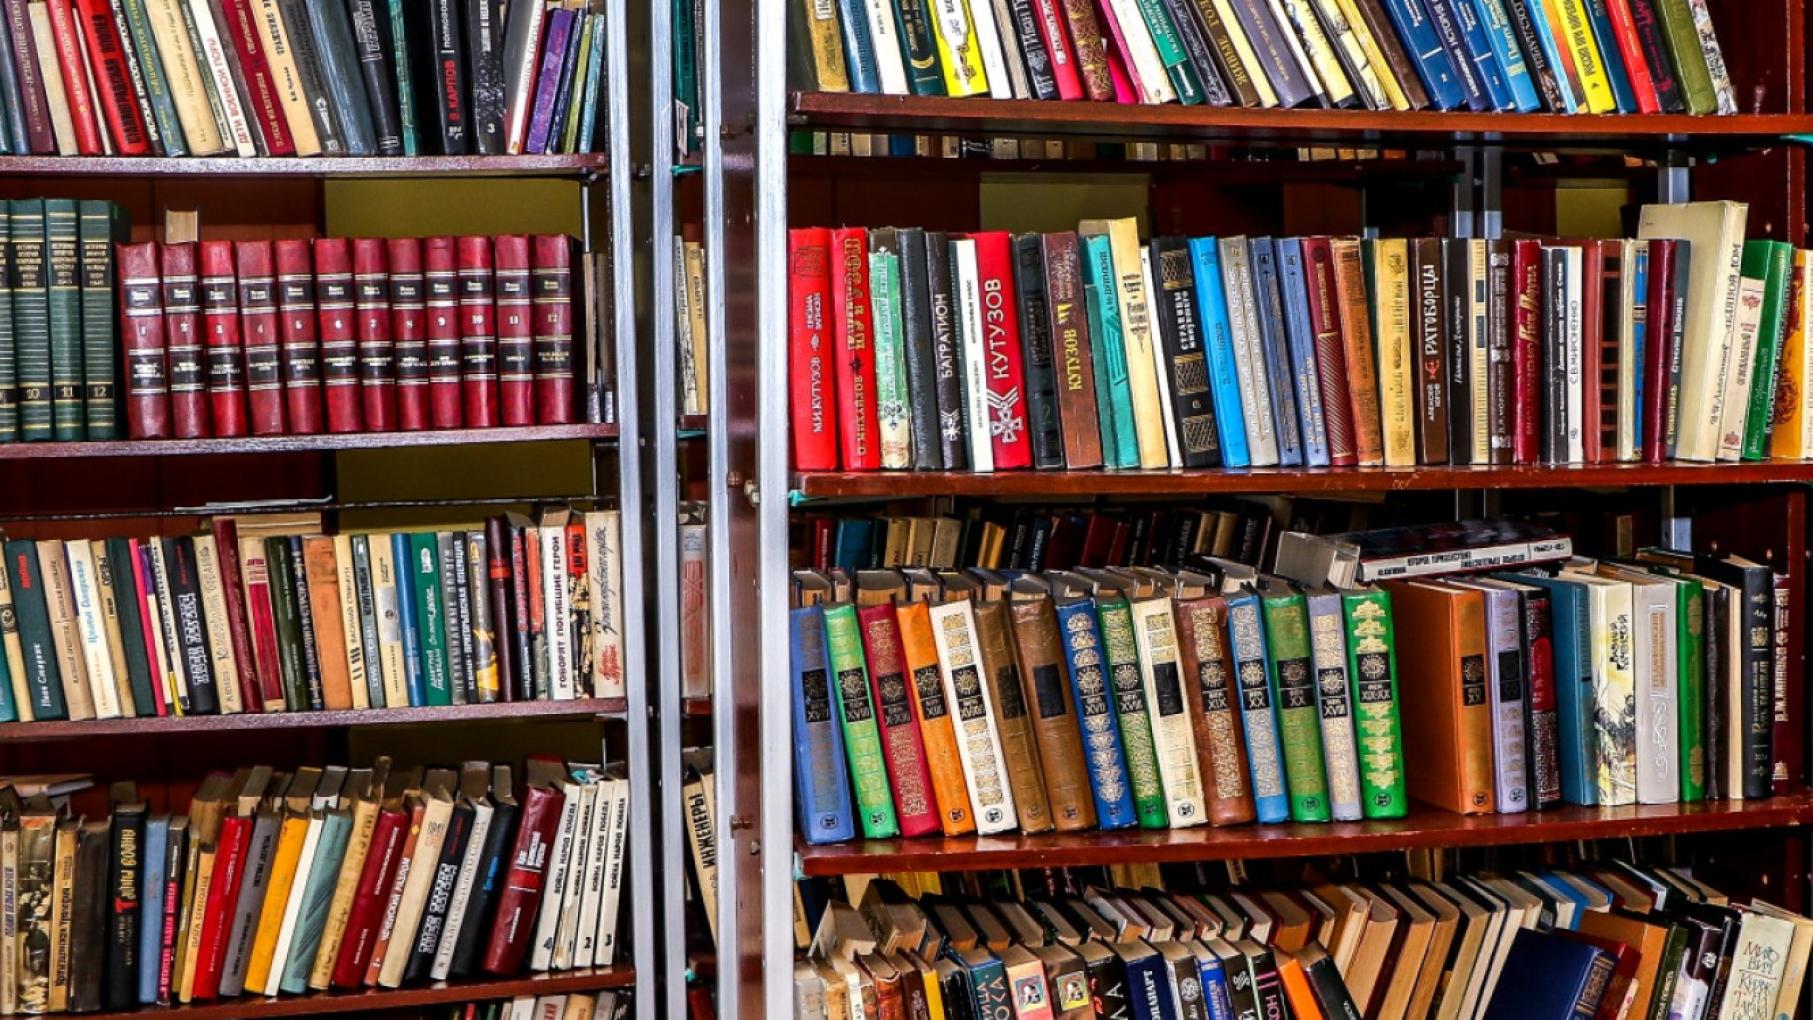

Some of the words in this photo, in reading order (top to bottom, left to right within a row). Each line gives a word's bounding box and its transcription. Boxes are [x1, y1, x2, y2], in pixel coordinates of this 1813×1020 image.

[1214, 32, 1248, 87] ЖИВЫЕ
[443, 60, 462, 122] В.КАРПОВ
[437, 316, 447, 327] 9
[472, 314, 486, 326] 10
[509, 315, 521, 326] 11
[1172, 289, 1190, 351] СТРАНИЦЫ
[1420, 263, 1441, 355] РАТОБОРЦЫ
[256, 323, 265, 334] 4
[930, 291, 956, 378] БАГРАТИОН
[980, 277, 1012, 379] КУТУЗОВ
[1061, 326, 1083, 391] КУТУЗОВ
[27, 387, 41, 399] 10
[62, 386, 73, 398] 11
[94, 386, 107, 397] 12
[550, 534, 561, 570] ГЕРОИ
[552, 572, 565, 636] ПОГИБШИЕ
[556, 640, 568, 688] ГОВОРЯТ
[563, 801, 577, 834] ПОБЕДА
[598, 799, 609, 832] ПОБЕДА
[615, 795, 625, 830] ПОБЕДА
[613, 830, 622, 860] НАРОД
[688, 793, 716, 868] ИНЖЕНЕРЫ
[558, 835, 571, 865] НАРОД
[593, 833, 604, 862] НАРОД
[552, 865, 565, 894] ВОЙНА
[573, 868, 582, 896] ВОЙНА
[589, 863, 601, 892] ВОЙНА
[610, 861, 619, 889] ВОЙНА
